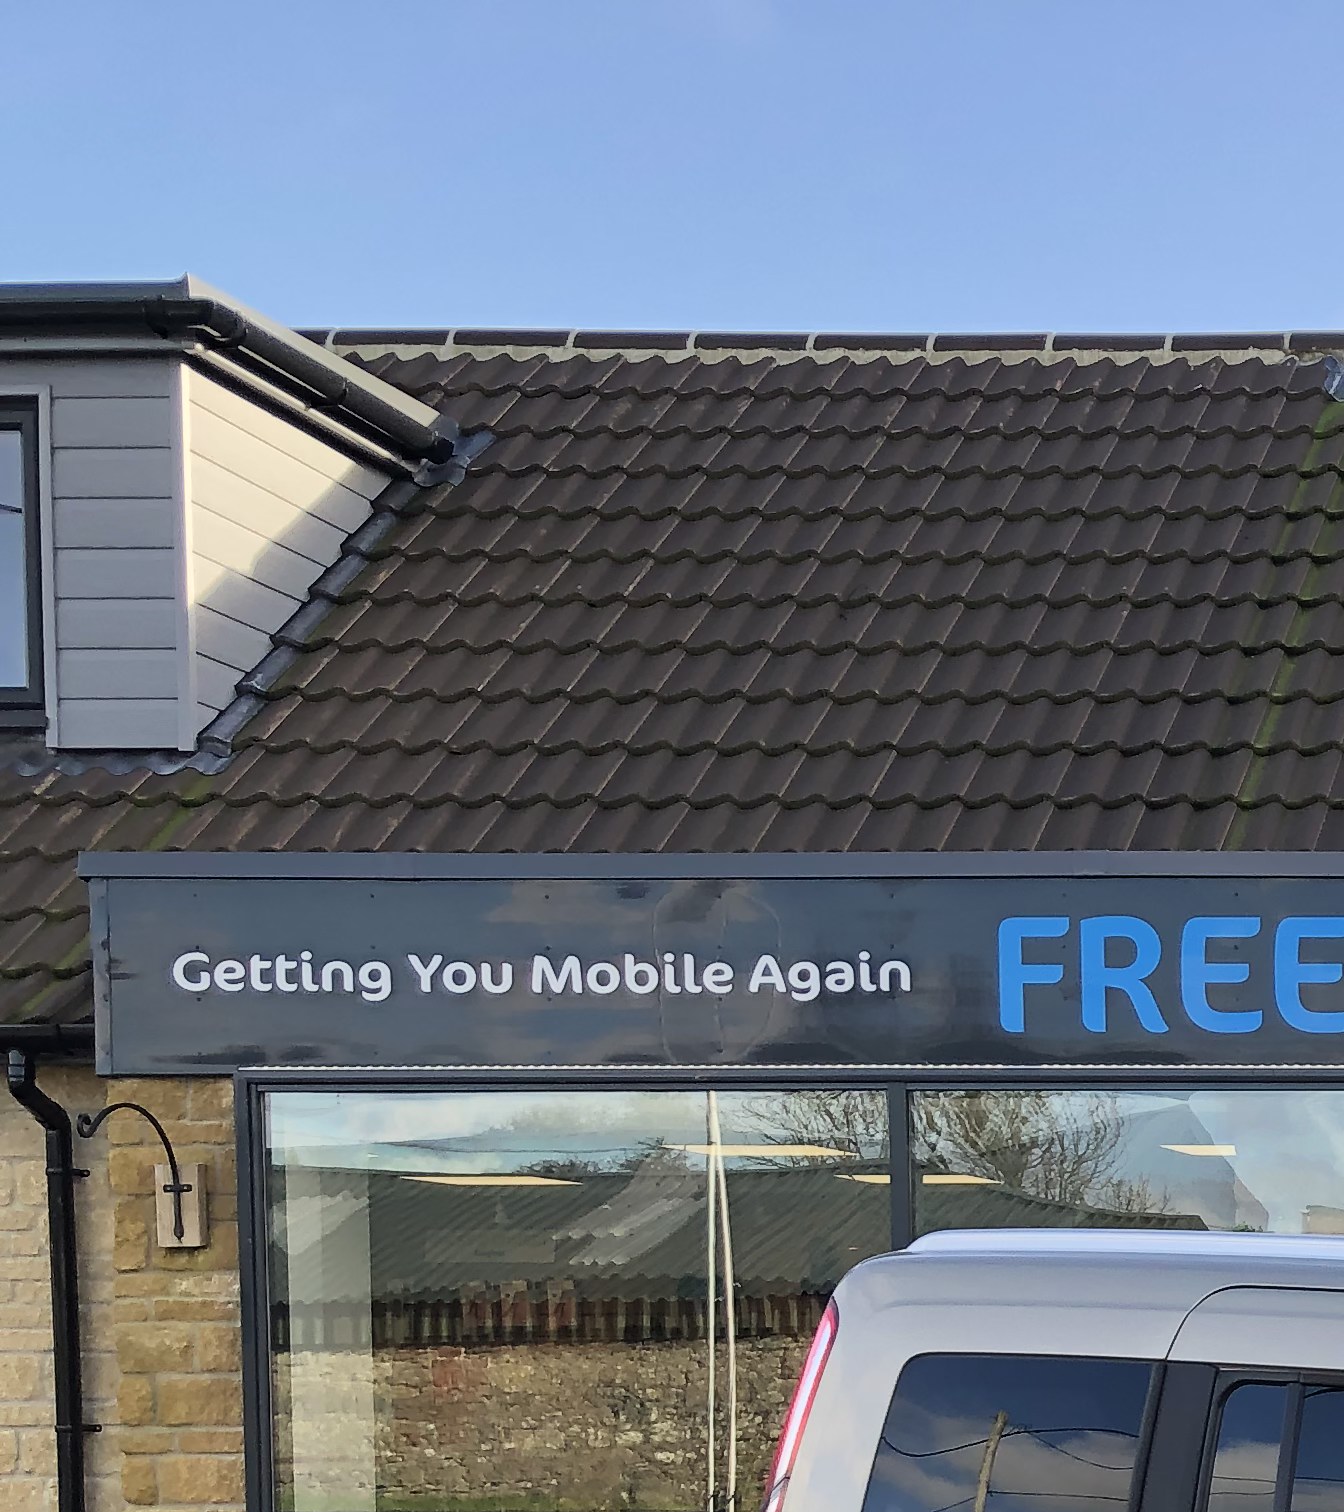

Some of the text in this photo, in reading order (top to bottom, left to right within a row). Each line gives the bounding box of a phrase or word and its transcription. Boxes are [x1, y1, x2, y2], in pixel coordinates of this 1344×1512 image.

[172, 949, 912, 1002] Getting You Mobile Again
